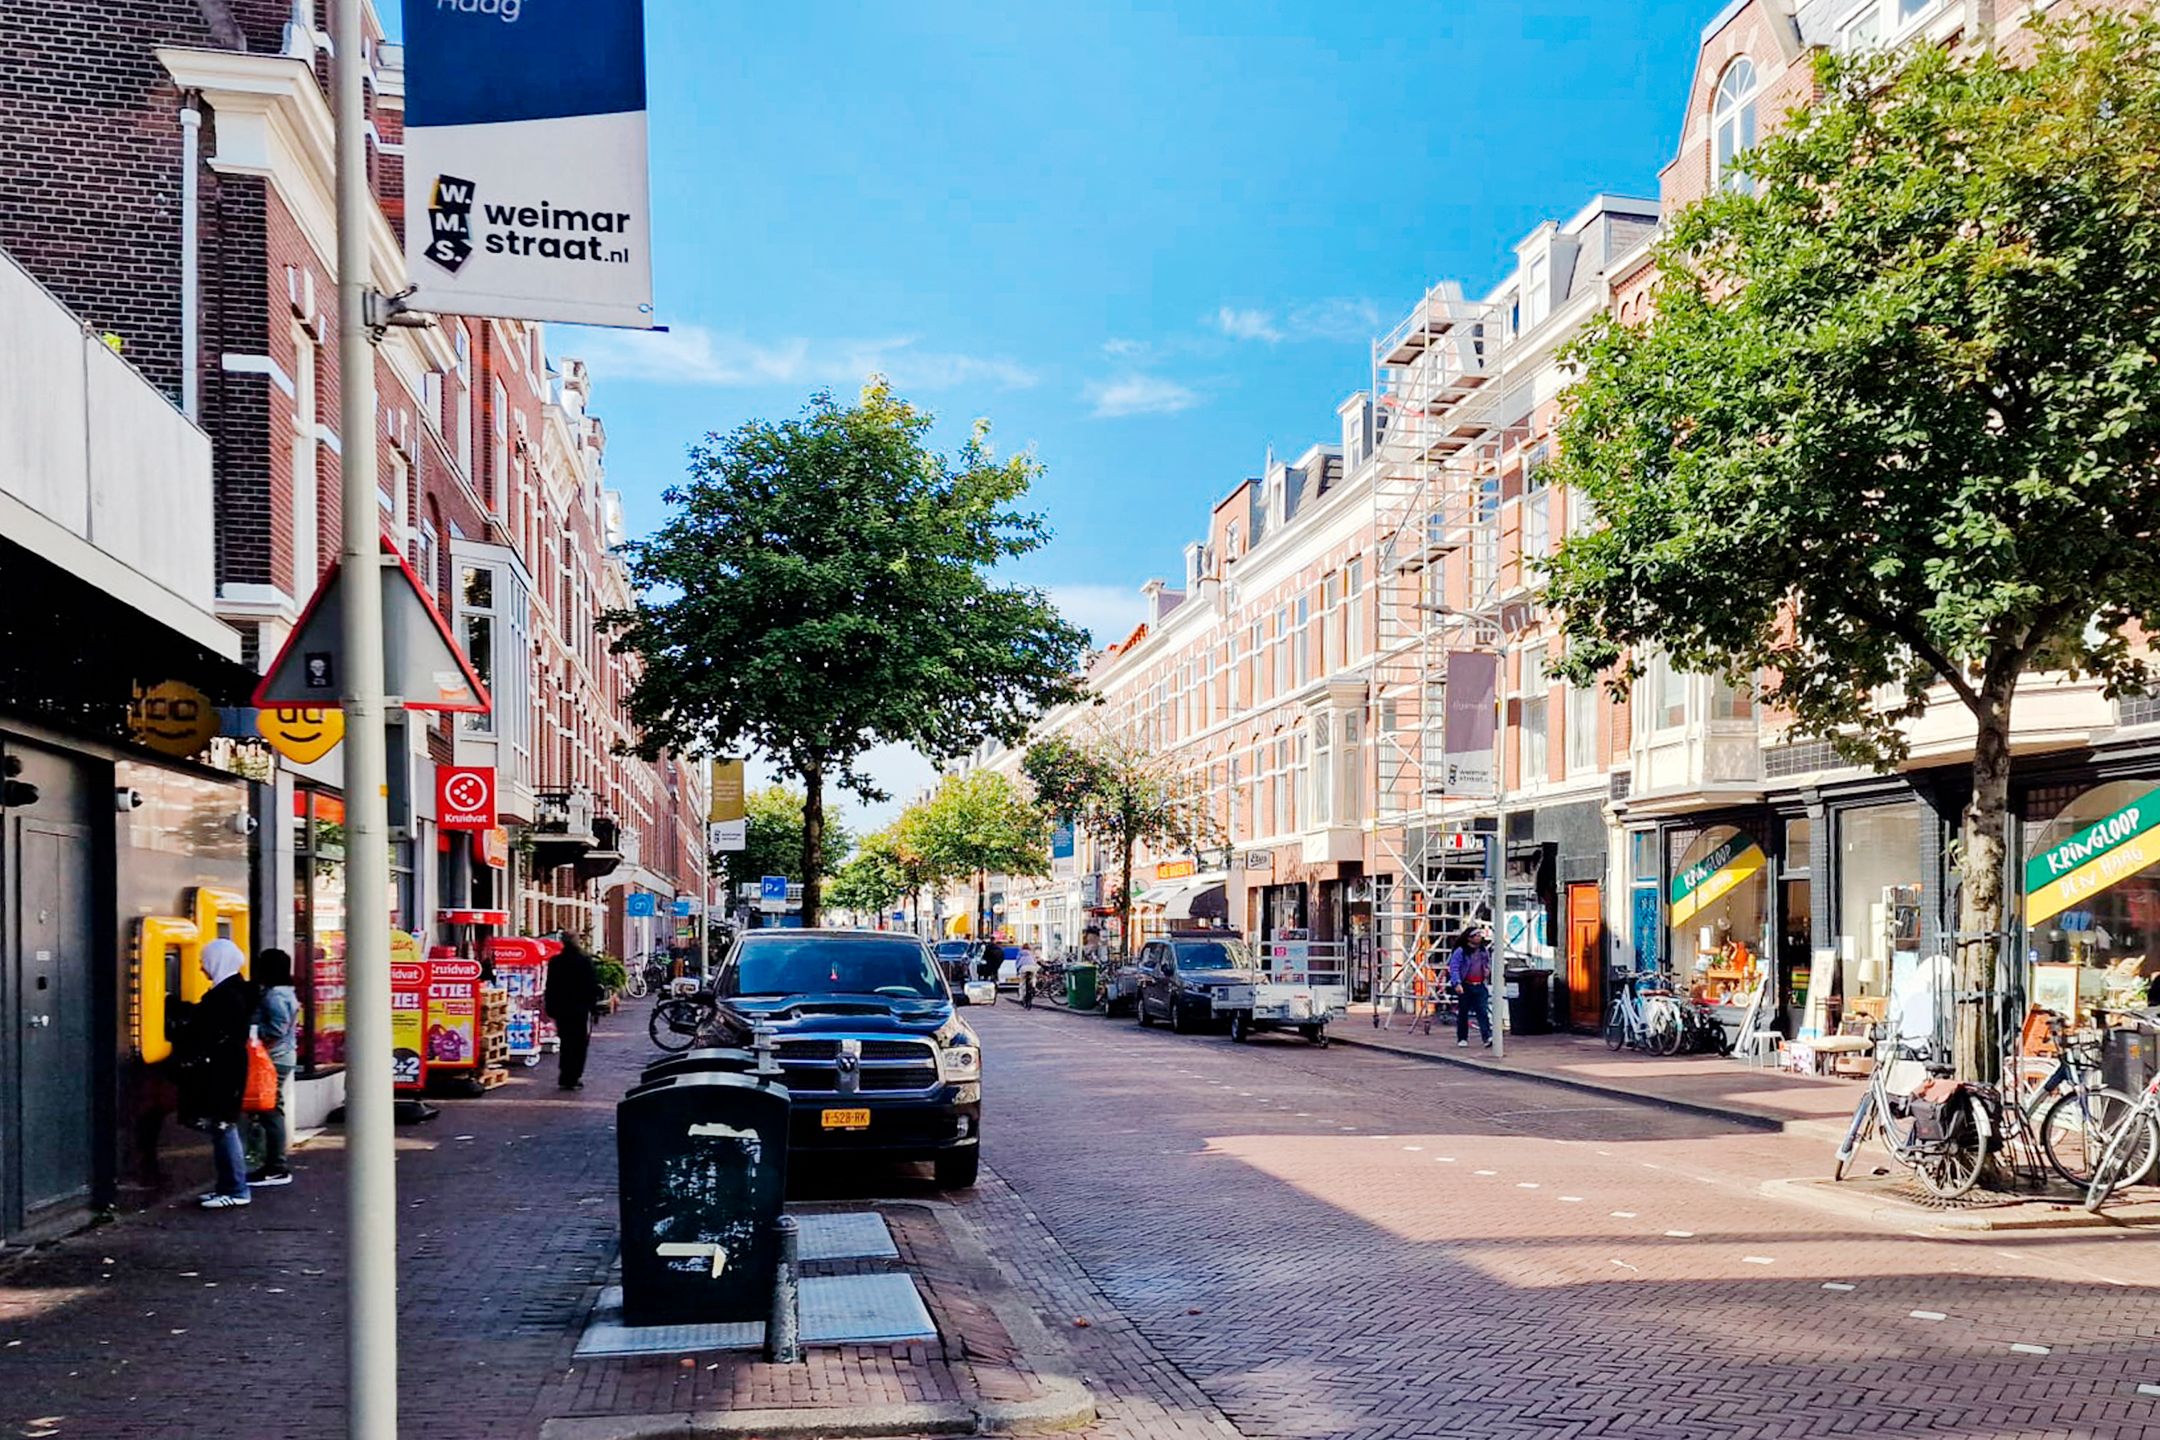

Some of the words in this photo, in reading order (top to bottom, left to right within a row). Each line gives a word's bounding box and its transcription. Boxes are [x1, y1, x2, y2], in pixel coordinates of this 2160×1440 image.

[484, 201, 630, 233] weimar
[485, 230, 629, 263] straat.nl
[444, 813, 488, 823] Kruidvat
[2047, 808, 2139, 874] KRINGLOOP
[428, 983, 472, 998] CTIE!
